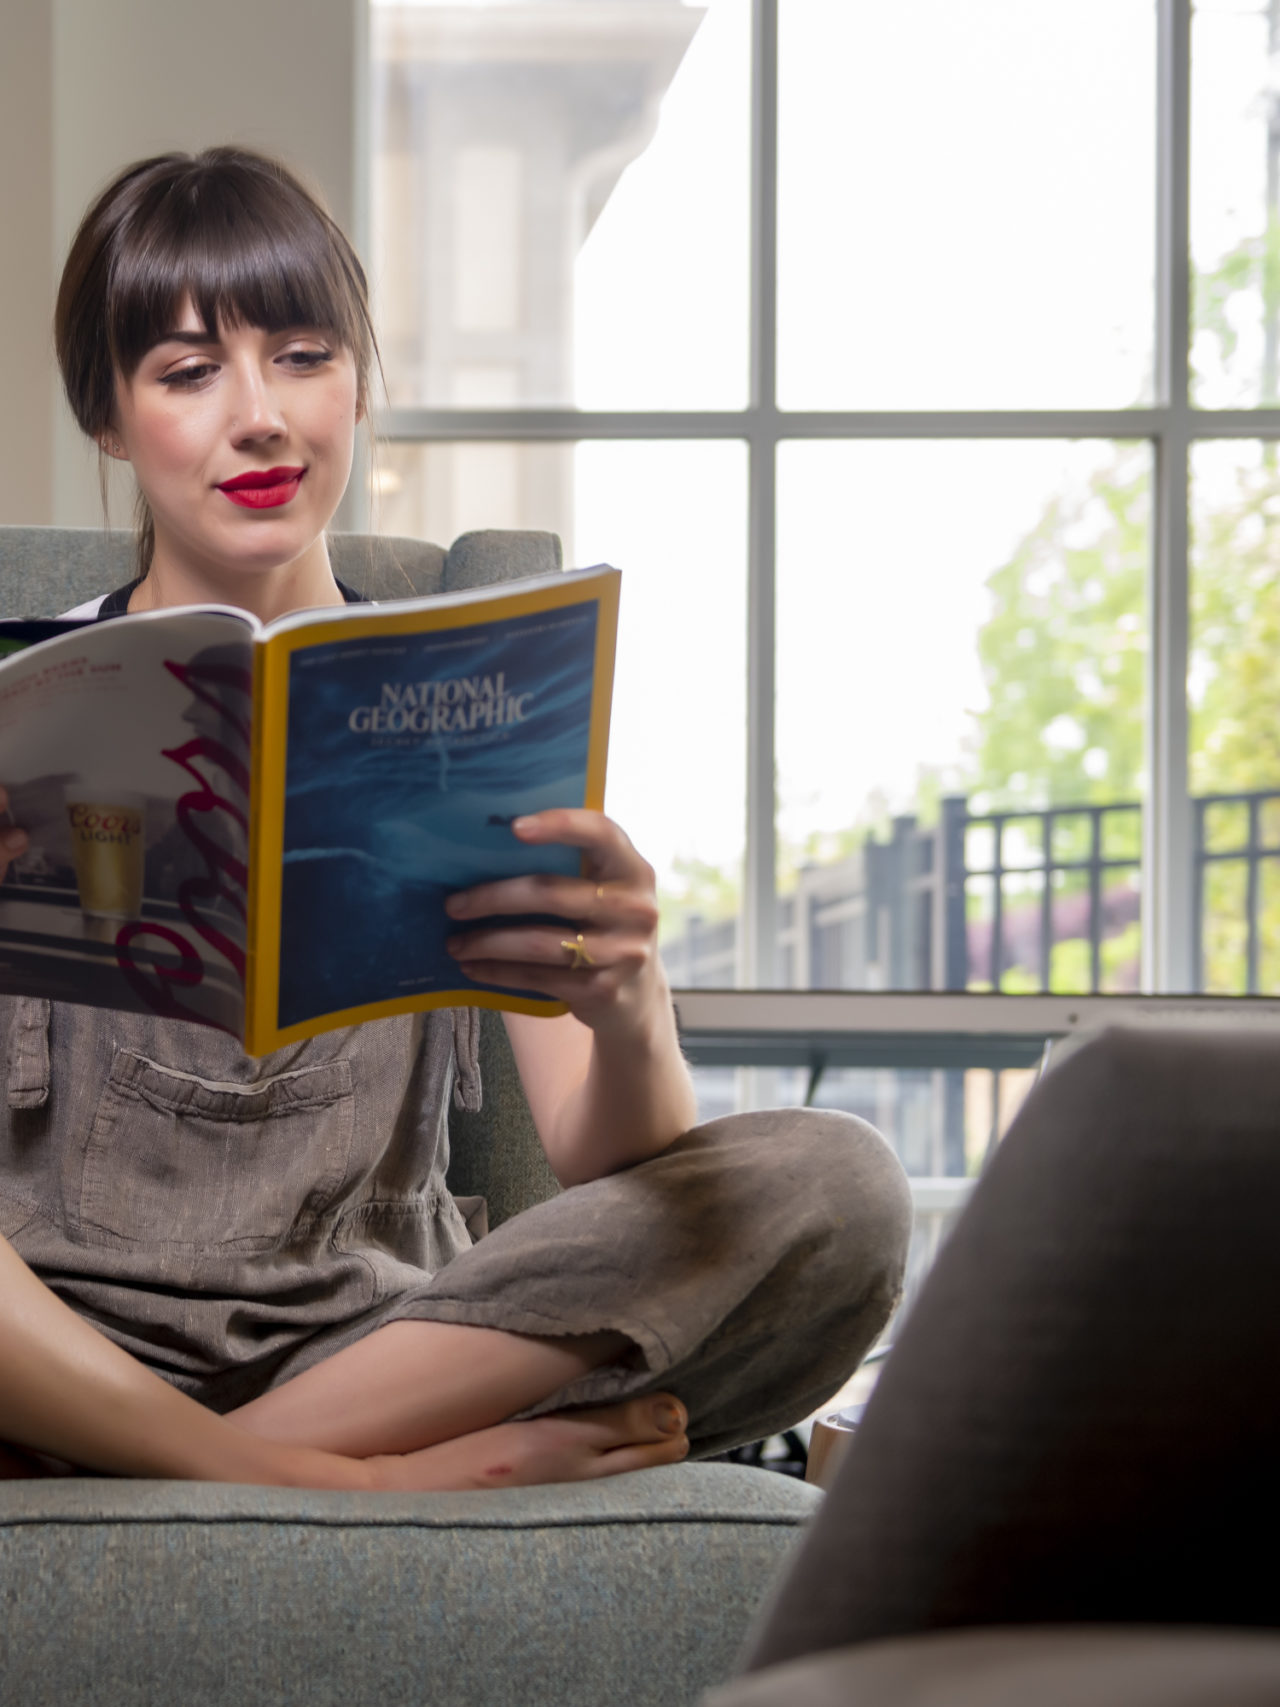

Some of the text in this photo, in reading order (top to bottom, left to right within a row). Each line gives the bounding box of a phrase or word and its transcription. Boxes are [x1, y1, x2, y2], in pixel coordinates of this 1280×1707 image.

[381, 672, 505, 709] NATIONAL
[348, 692, 533, 734] GEOGRAPHIC
[66, 802, 141, 835] Coors
[81, 829, 131, 846] LIGHT
